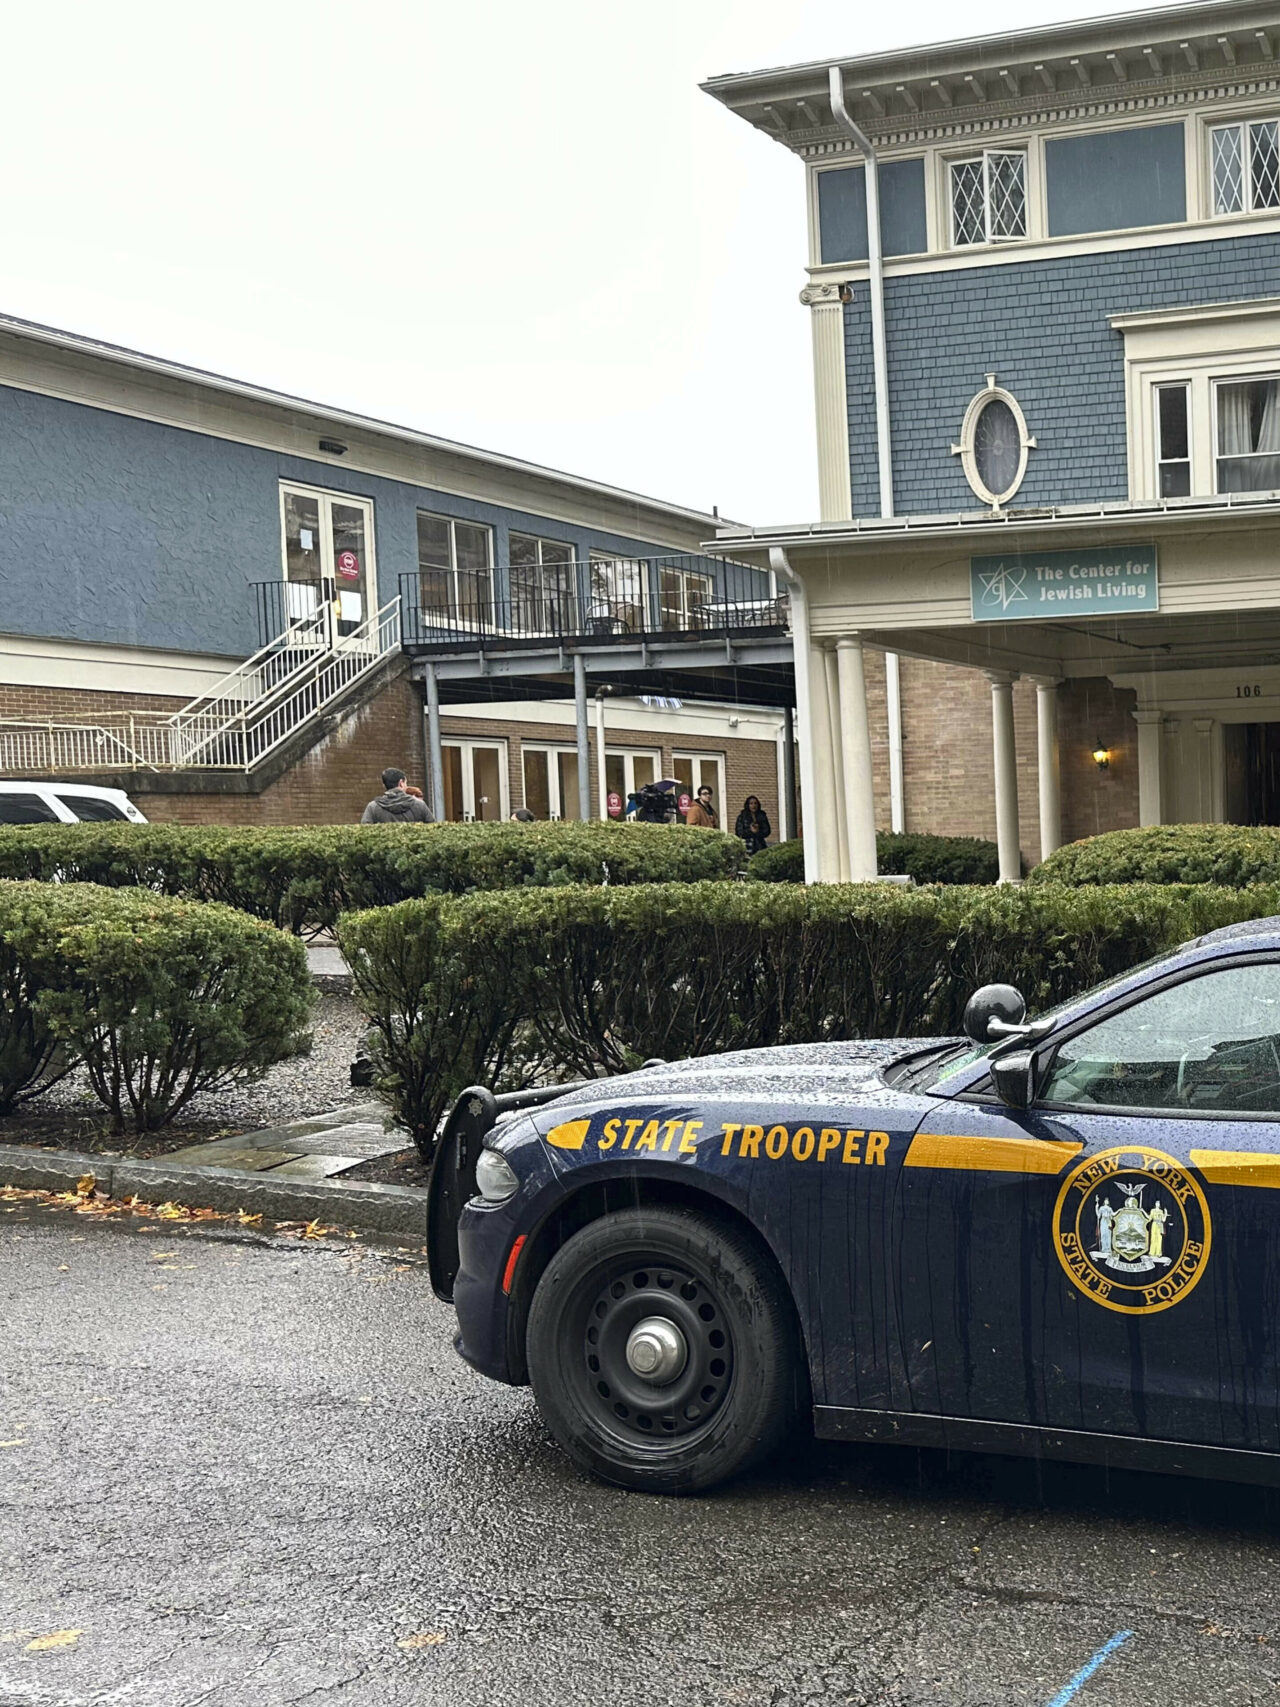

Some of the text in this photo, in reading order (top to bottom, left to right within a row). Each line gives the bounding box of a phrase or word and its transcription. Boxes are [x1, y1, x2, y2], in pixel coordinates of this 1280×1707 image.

[1035, 560, 1150, 581] The Center for
[1039, 582, 1147, 601] Jewish Living
[1236, 684, 1261, 698] 106
[598, 1118, 891, 1167] STATE TROOPER
[1072, 1154, 1196, 1205] NEW YORK
[1060, 1232, 1204, 1306] STATE POLICE
